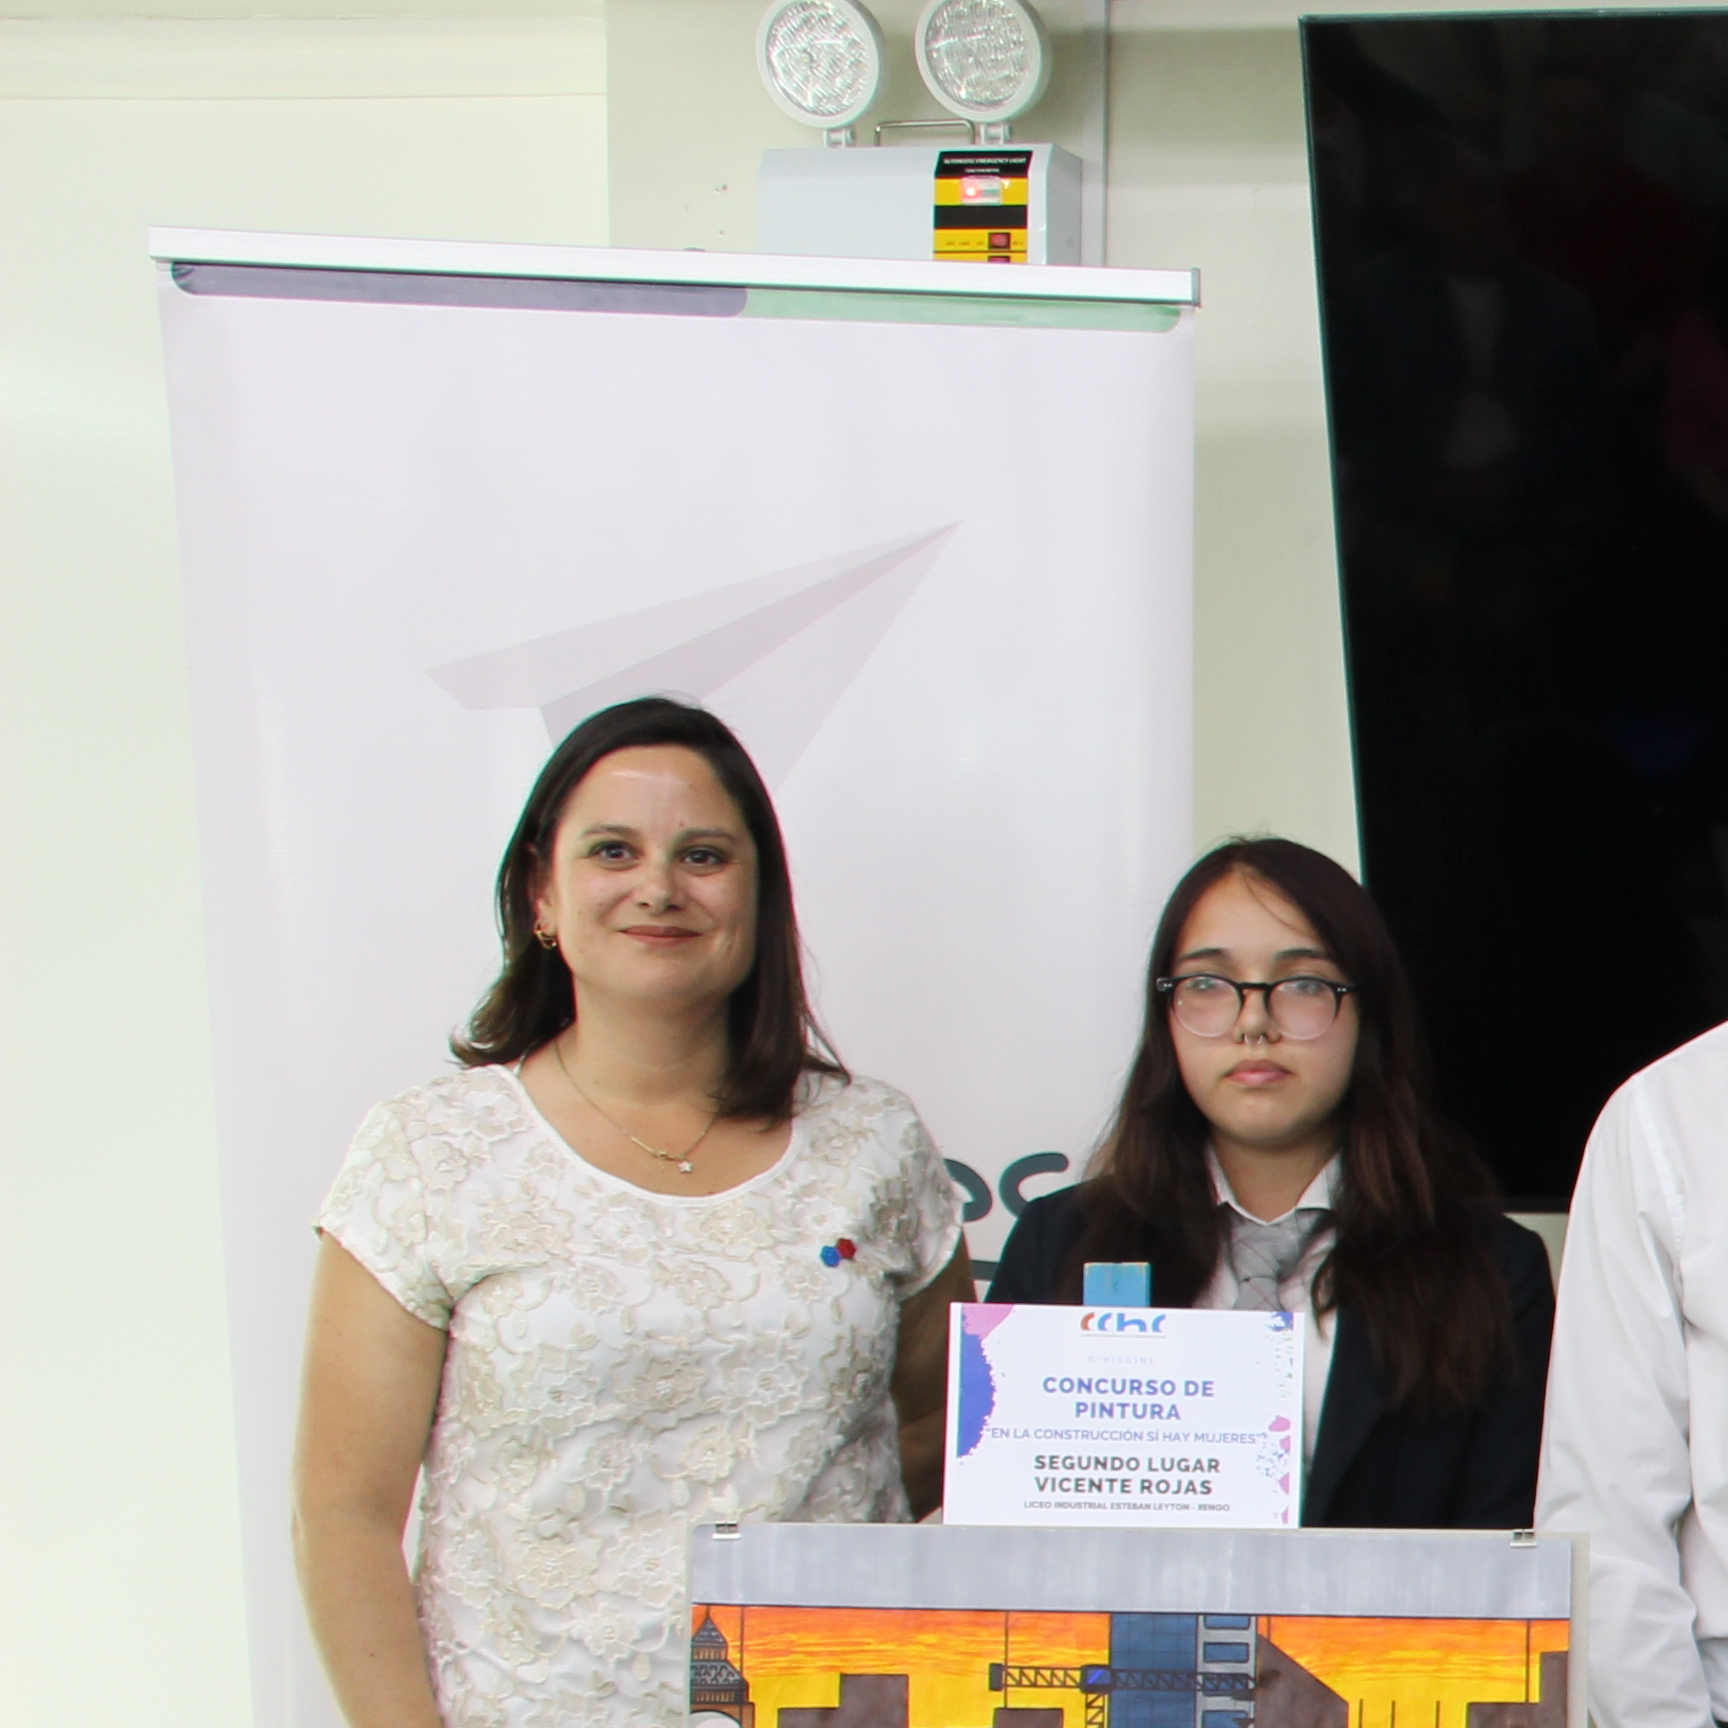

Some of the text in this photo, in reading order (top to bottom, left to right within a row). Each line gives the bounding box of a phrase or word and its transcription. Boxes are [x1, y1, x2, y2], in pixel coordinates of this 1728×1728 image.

[1042, 1376, 1214, 1398] CONCURSO DE
[1074, 1402, 1182, 1421] PINTURA
[1013, 1428, 1031, 1440] LA
[1034, 1427, 1144, 1442] CONSTRUCCIÓN
[1147, 1428, 1160, 1442] SÍ
[1162, 1431, 1190, 1443] HAY
[1033, 1454, 1221, 1474] SEGUNDO LUGAR
[1034, 1476, 1213, 1496] VICENTE ROJAS
[1024, 1500, 1052, 1509] LICEO
[1054, 1501, 1108, 1510] INDUSTRIAL
[1110, 1502, 1152, 1511] ESTEBAN
[1153, 1503, 1190, 1512] LEYTON
[1198, 1504, 1231, 1512] RENGO
